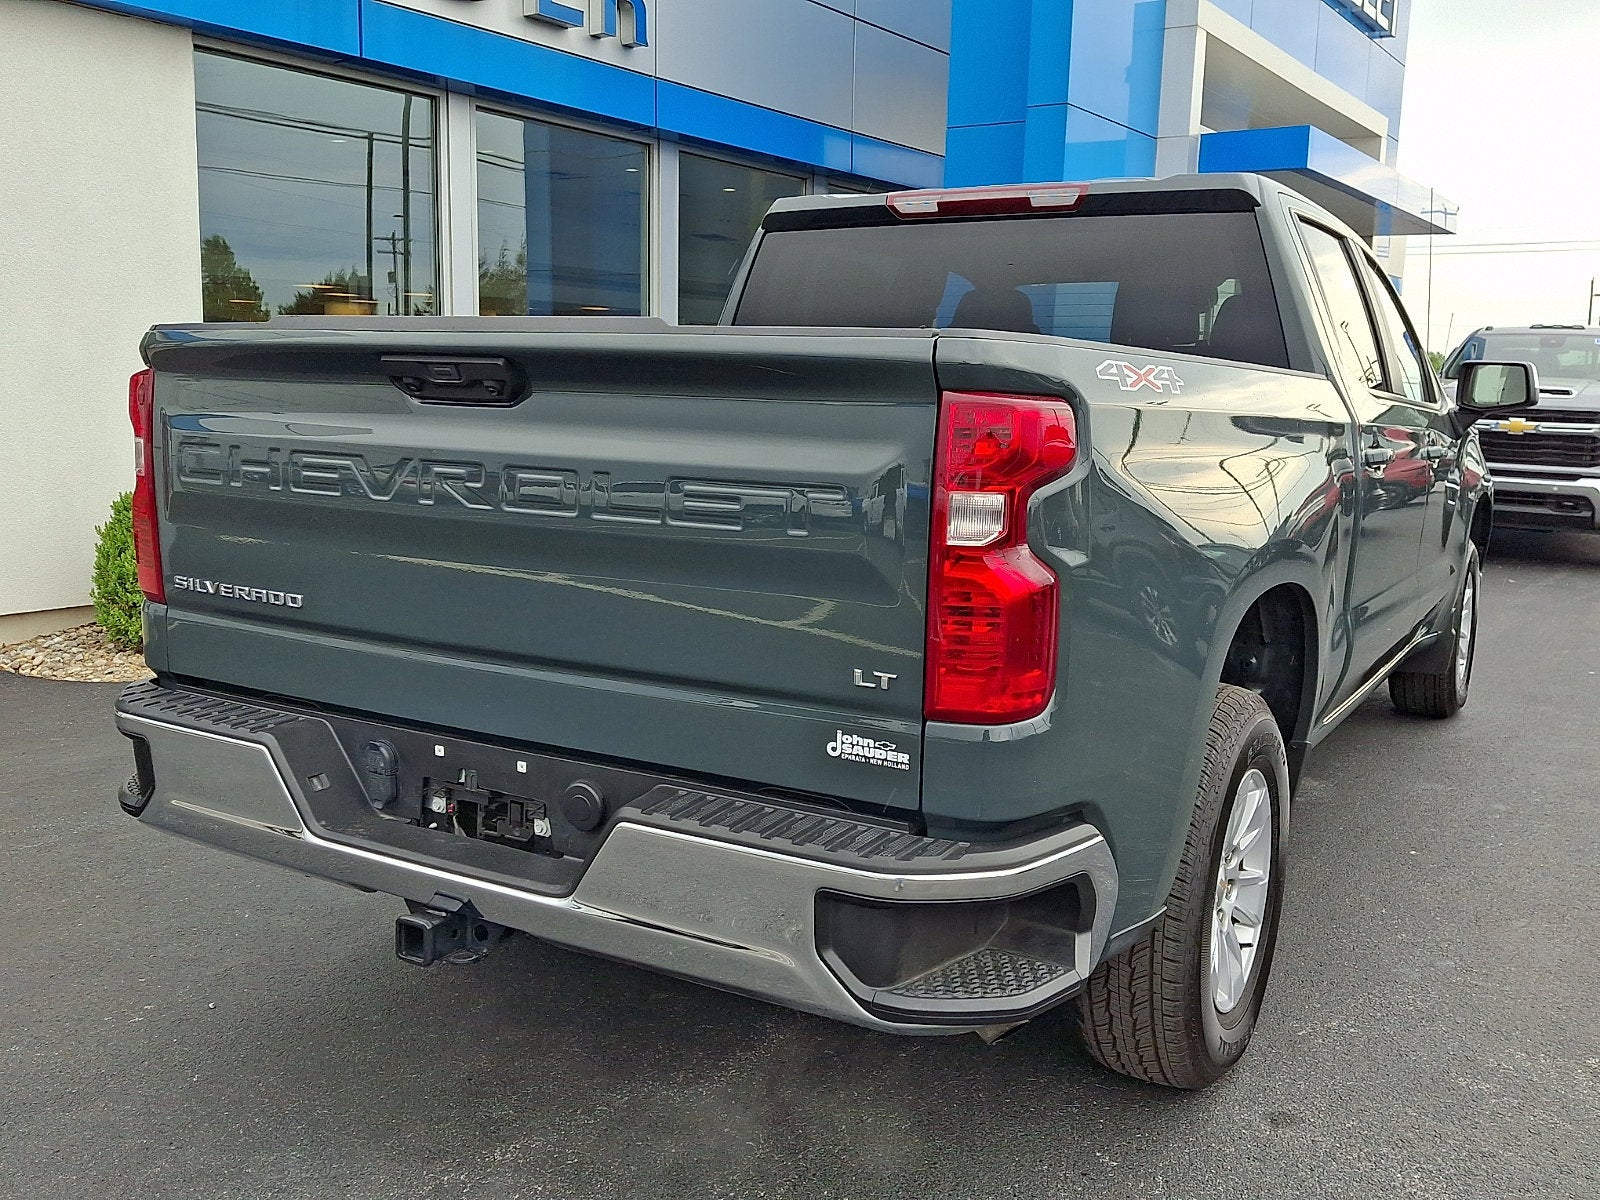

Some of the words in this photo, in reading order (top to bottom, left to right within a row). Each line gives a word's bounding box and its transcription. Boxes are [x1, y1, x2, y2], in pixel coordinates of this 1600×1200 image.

[177, 440, 848, 537] CHEVROLET
[173, 575, 304, 609] SILVERADO
[853, 668, 898, 690] LT
[841, 743, 910, 764] SAUDER
[841, 753, 866, 763] EPHRATA
[869, 758, 883, 766] NEW
[883, 760, 910, 771] HOLLAND
